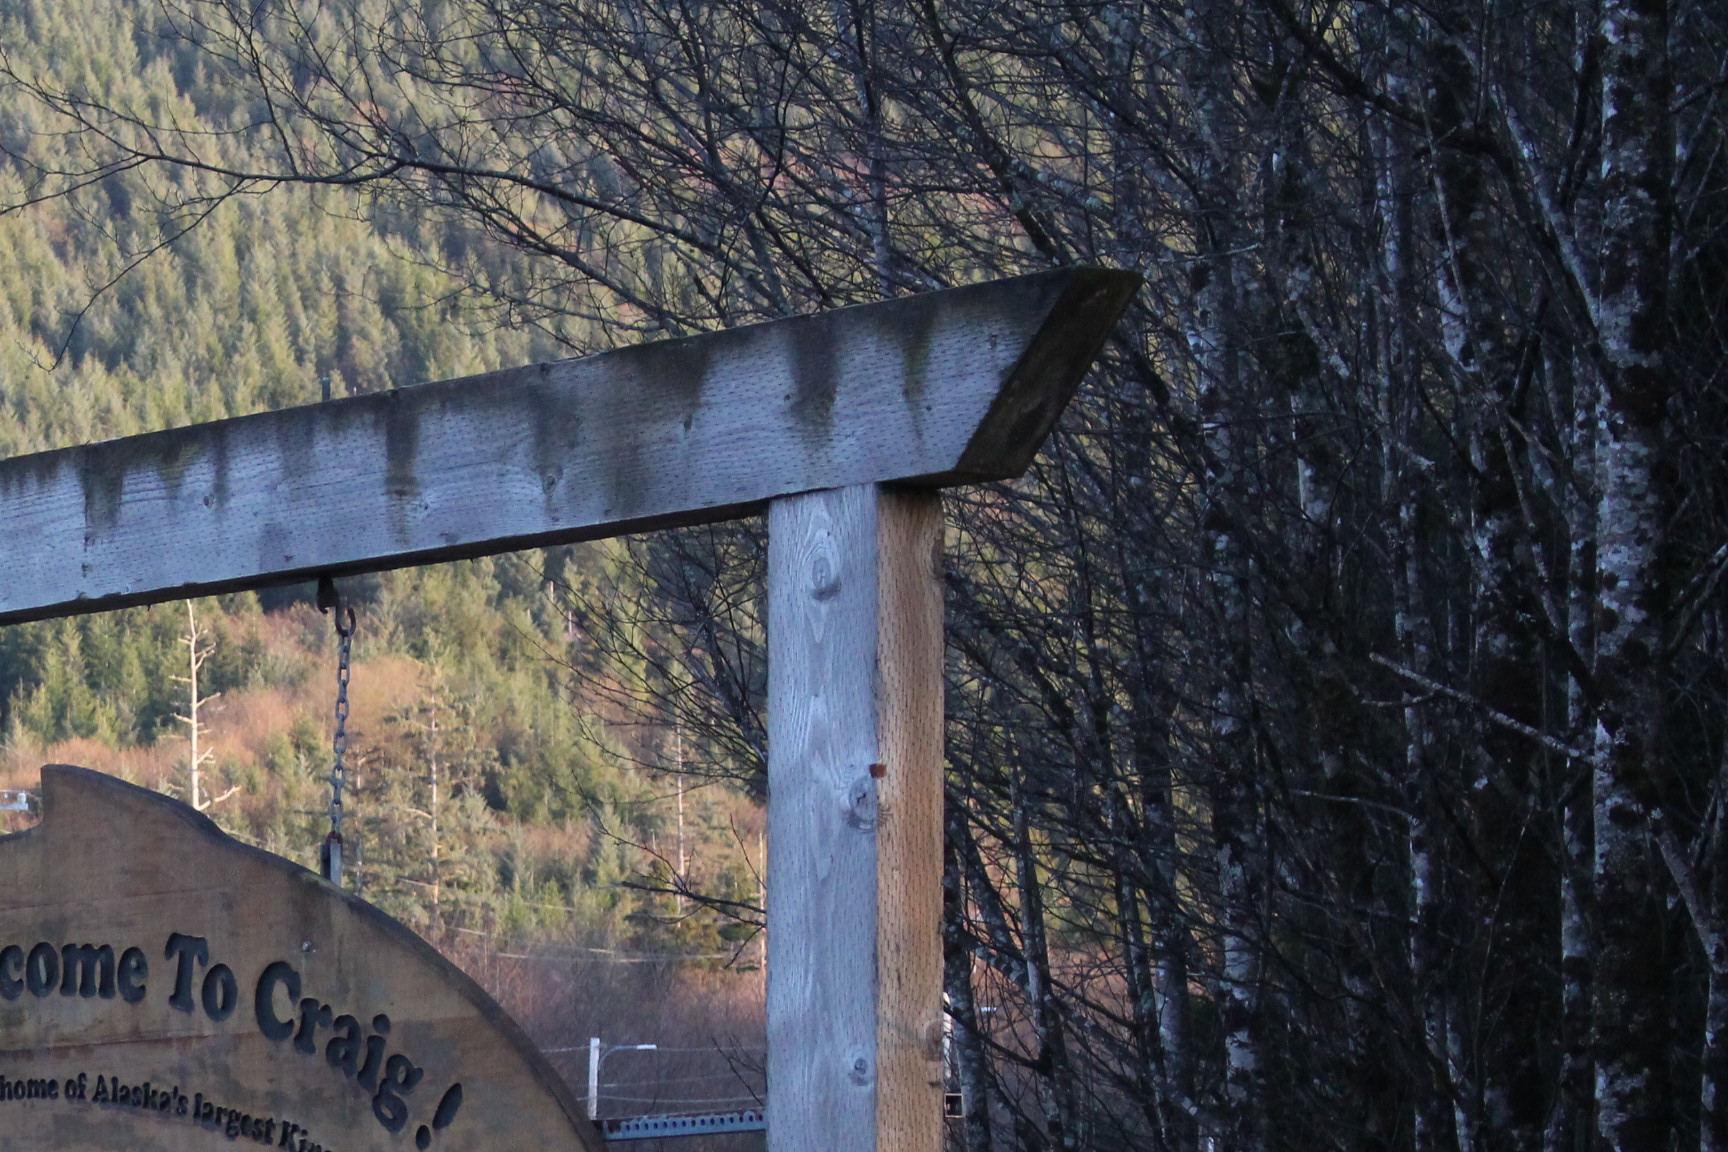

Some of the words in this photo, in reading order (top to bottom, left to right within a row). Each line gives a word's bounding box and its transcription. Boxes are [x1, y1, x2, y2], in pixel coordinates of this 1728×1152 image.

[165, 932, 238, 1022] To
[0, 1074, 59, 1101] home
[65, 1072, 87, 1101] of
[93, 1073, 188, 1118] Alaska's
[193, 1092, 275, 1142] largest
